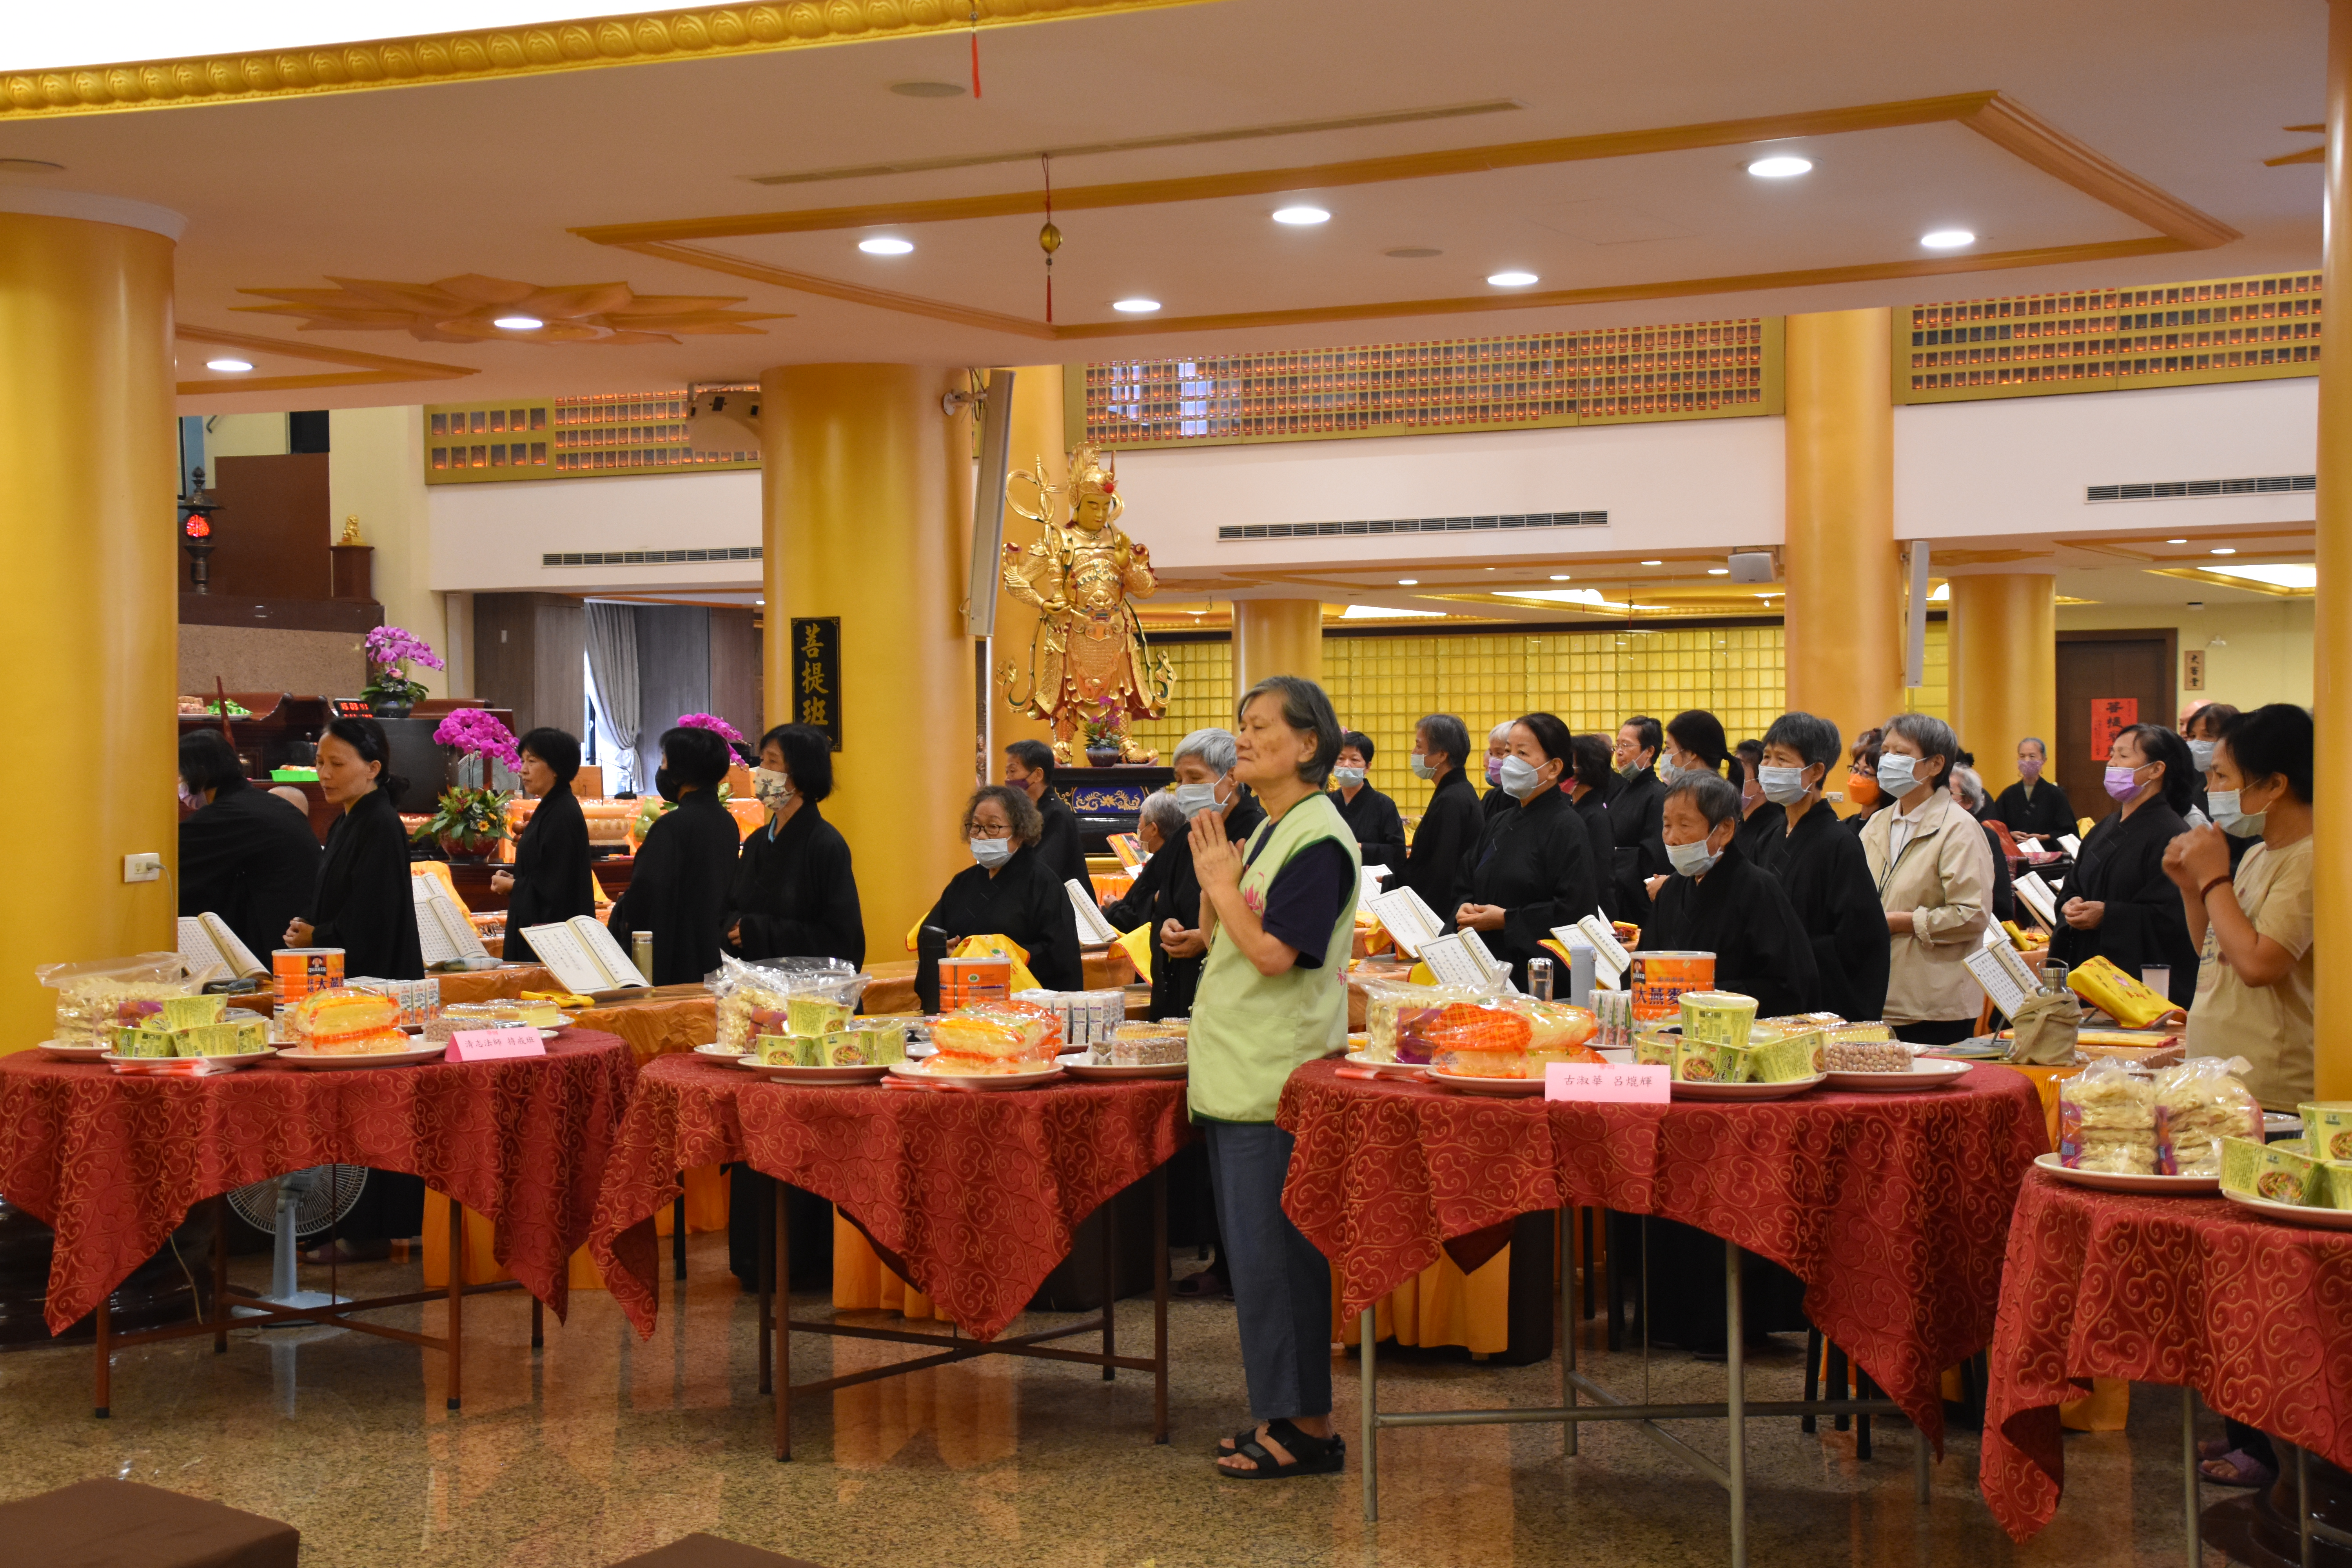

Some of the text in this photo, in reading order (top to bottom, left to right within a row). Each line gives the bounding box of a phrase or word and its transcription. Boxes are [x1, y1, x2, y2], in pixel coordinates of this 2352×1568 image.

[308, 978, 314, 993] 桂格
[1636, 986, 1695, 1006] 大燕麥
[465, 1036, 535, 1048] 清志法師 持戒班
[1564, 1074, 1603, 1086] 古淑華
